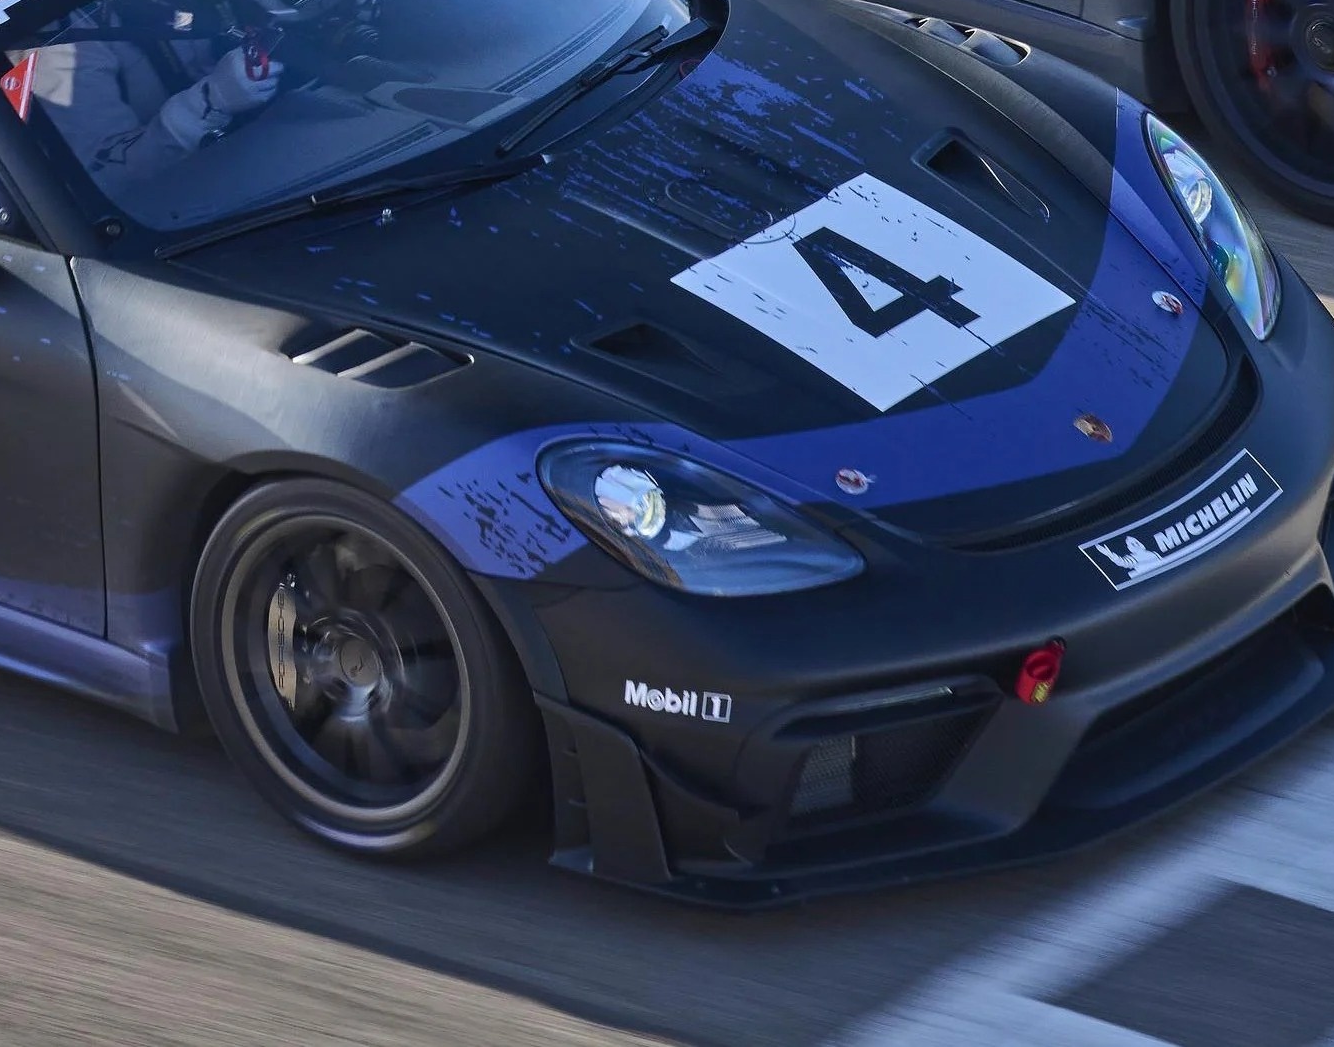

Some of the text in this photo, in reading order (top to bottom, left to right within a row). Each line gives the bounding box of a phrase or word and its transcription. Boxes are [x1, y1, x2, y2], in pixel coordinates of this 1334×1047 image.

[790, 225, 981, 339] 4
[1153, 472, 1259, 554] MICHELIN
[624, 678, 698, 717] Mobil
